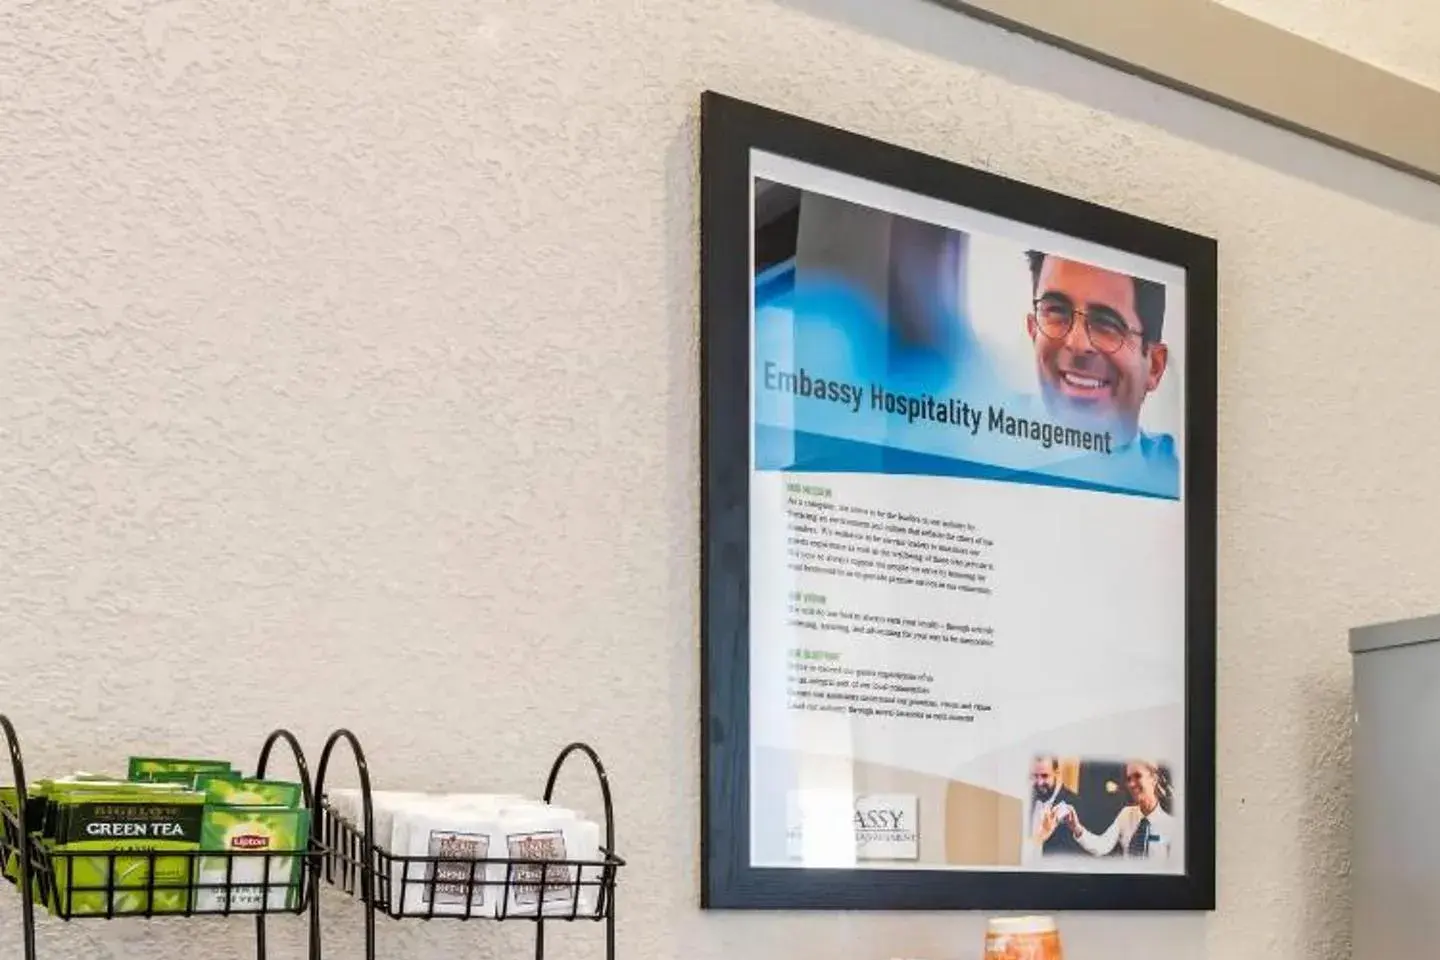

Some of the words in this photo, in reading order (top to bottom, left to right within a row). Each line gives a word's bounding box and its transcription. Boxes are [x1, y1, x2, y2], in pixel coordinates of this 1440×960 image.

[764, 360, 863, 413] Embassy
[871, 383, 982, 436] Hospitality
[987, 404, 1113, 455] Management
[86, 822, 148, 836] GREEN
[151, 822, 185, 836] TEA
[233, 836, 267, 848] Lipton
